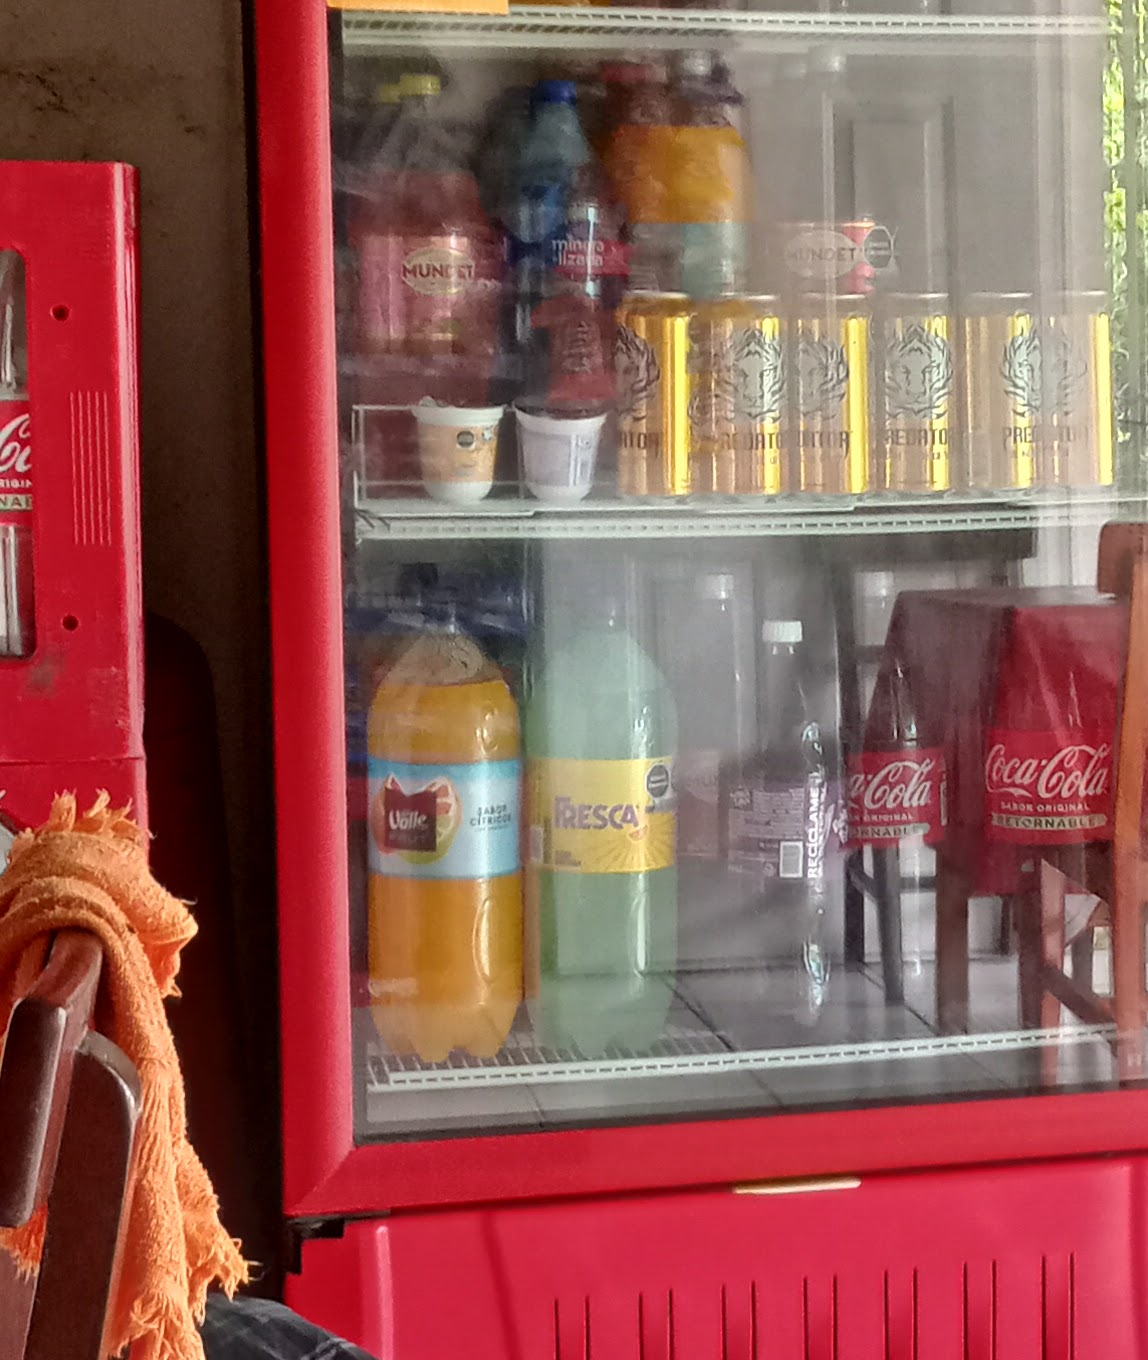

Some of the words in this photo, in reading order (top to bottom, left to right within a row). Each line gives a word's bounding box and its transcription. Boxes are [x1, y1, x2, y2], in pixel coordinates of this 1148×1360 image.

[849, 757, 936, 810] a-Cola
[984, 743, 1113, 799] Coca-Cola
[388, 808, 428, 830] Valle
[554, 795, 640, 831] FRESCA
